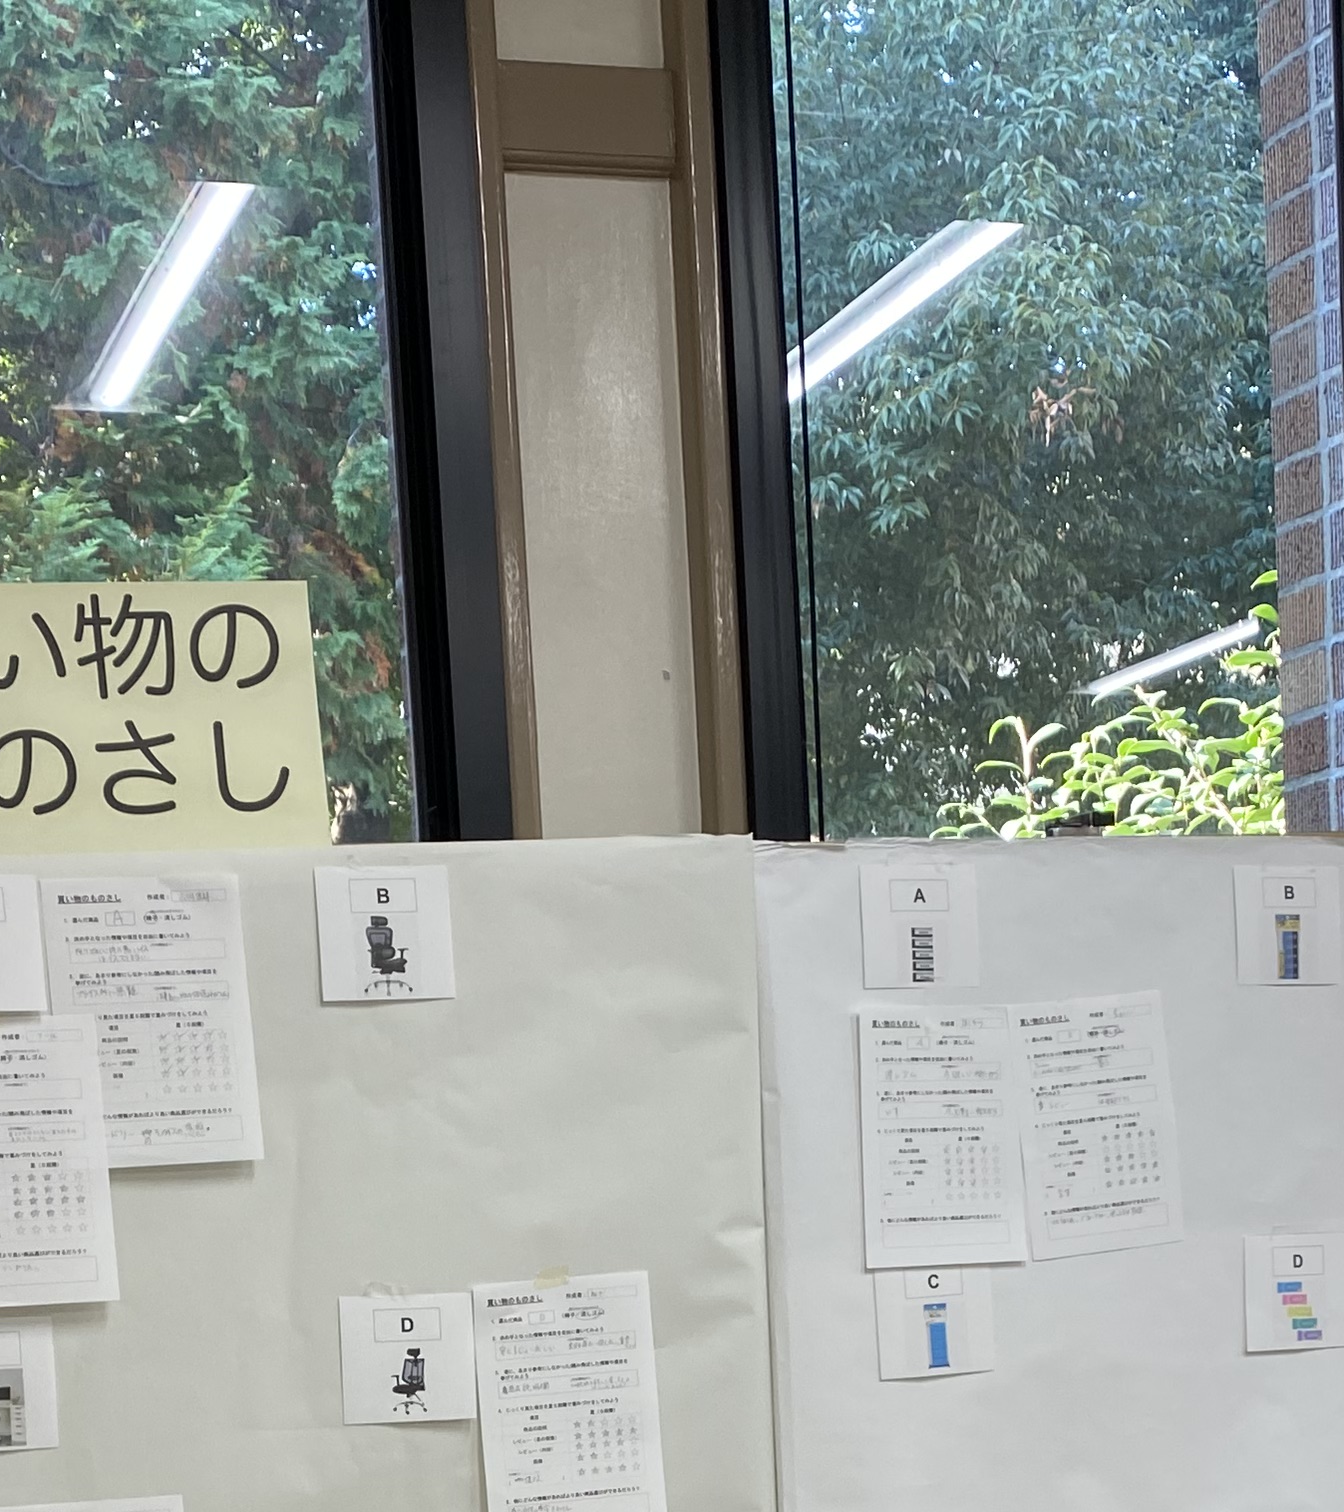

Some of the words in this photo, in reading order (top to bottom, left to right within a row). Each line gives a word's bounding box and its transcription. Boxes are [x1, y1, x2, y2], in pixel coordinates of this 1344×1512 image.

[376, 887, 390, 904] B
[913, 888, 926, 904] A
[1284, 885, 1295, 900] B
[1293, 1254, 1303, 1268] D
[927, 1274, 940, 1289] C
[400, 1317, 415, 1333] D
